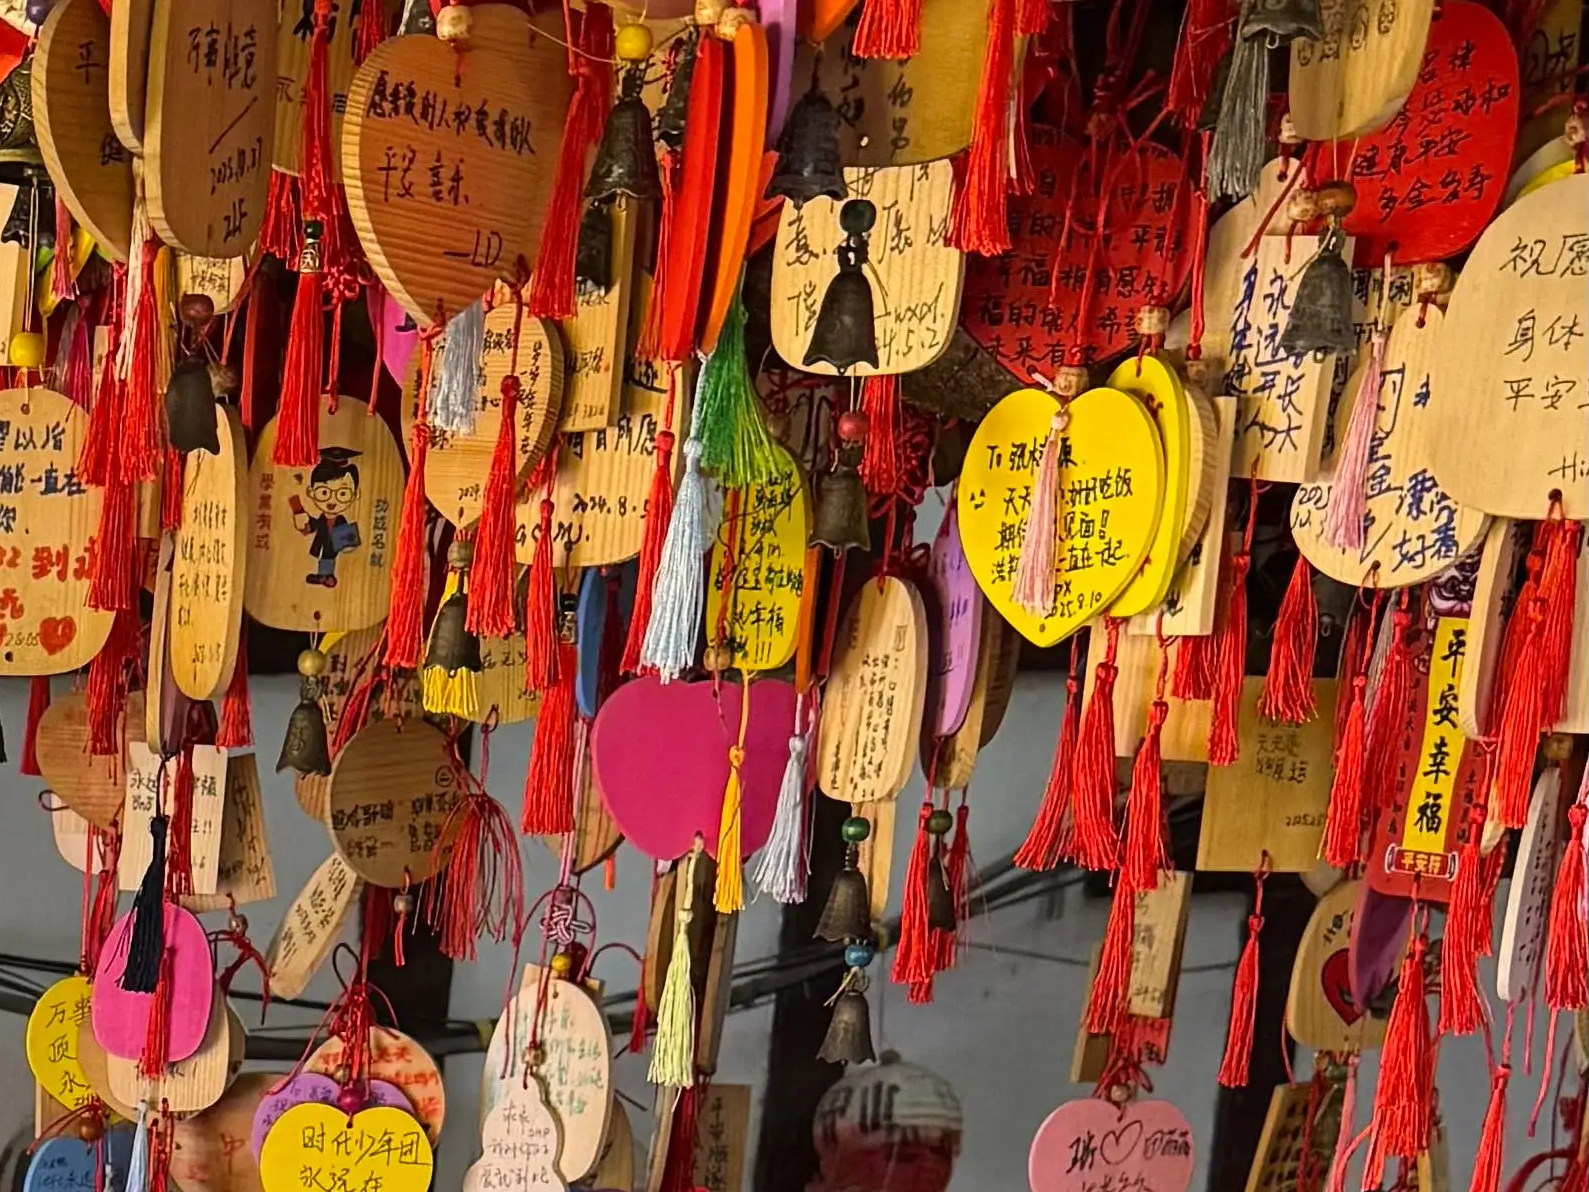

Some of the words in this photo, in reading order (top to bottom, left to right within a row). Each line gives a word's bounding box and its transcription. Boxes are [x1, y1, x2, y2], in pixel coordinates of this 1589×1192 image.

[1413, 628, 1469, 836] 平安幸福
[301, 1125, 432, 1168] 时代少年团
